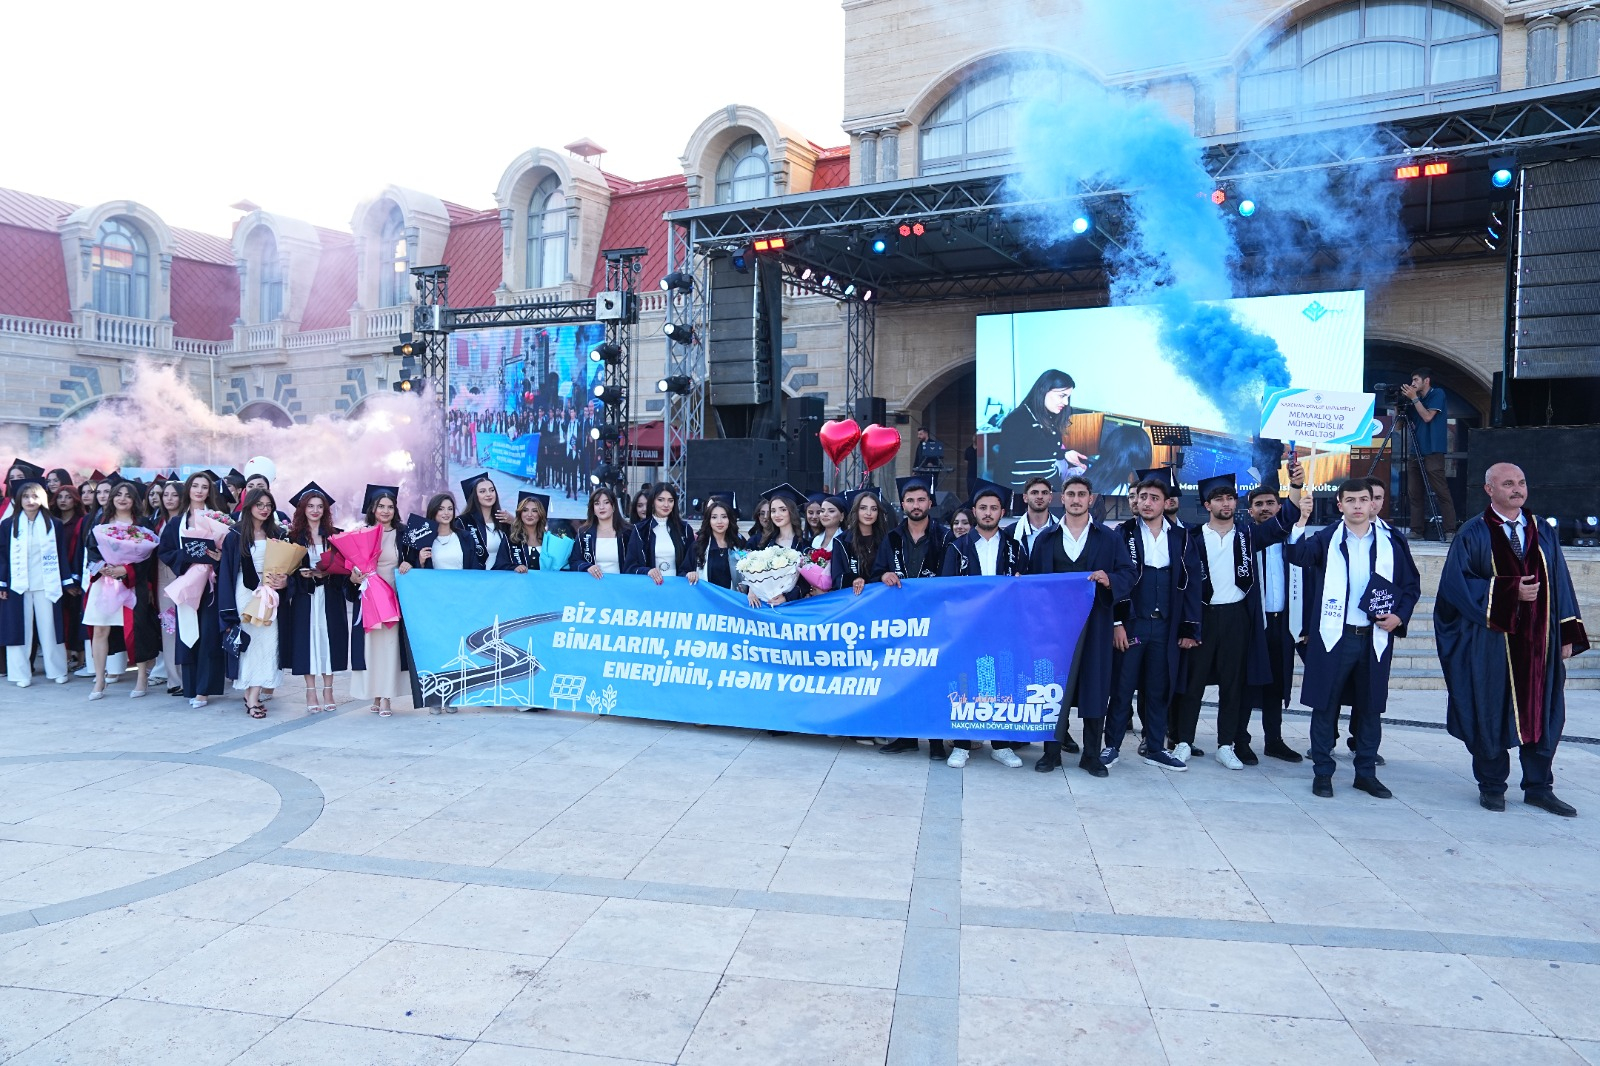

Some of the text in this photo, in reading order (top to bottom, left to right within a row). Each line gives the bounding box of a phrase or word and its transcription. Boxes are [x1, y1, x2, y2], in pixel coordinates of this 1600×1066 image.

[1288, 411, 1345, 422] MEMARLIQ VƏ
[1324, 603, 1343, 611] 2022
[561, 601, 931, 645] BİZ SABAHIN MEMARLARIYIQ: HƏM
[552, 626, 940, 671] BİNALARIN, HƏM SİSTEMLƏRİN, HƏM
[602, 659, 882, 696] ENERJİNİN, HƏM YOLLARIN
[1026, 683, 1064, 704] 20
[950, 702, 1043, 723] MƏZUN
[951, 721, 1057, 731] NAXÇIVAN DÖVLƏT UNİVERSİTET
